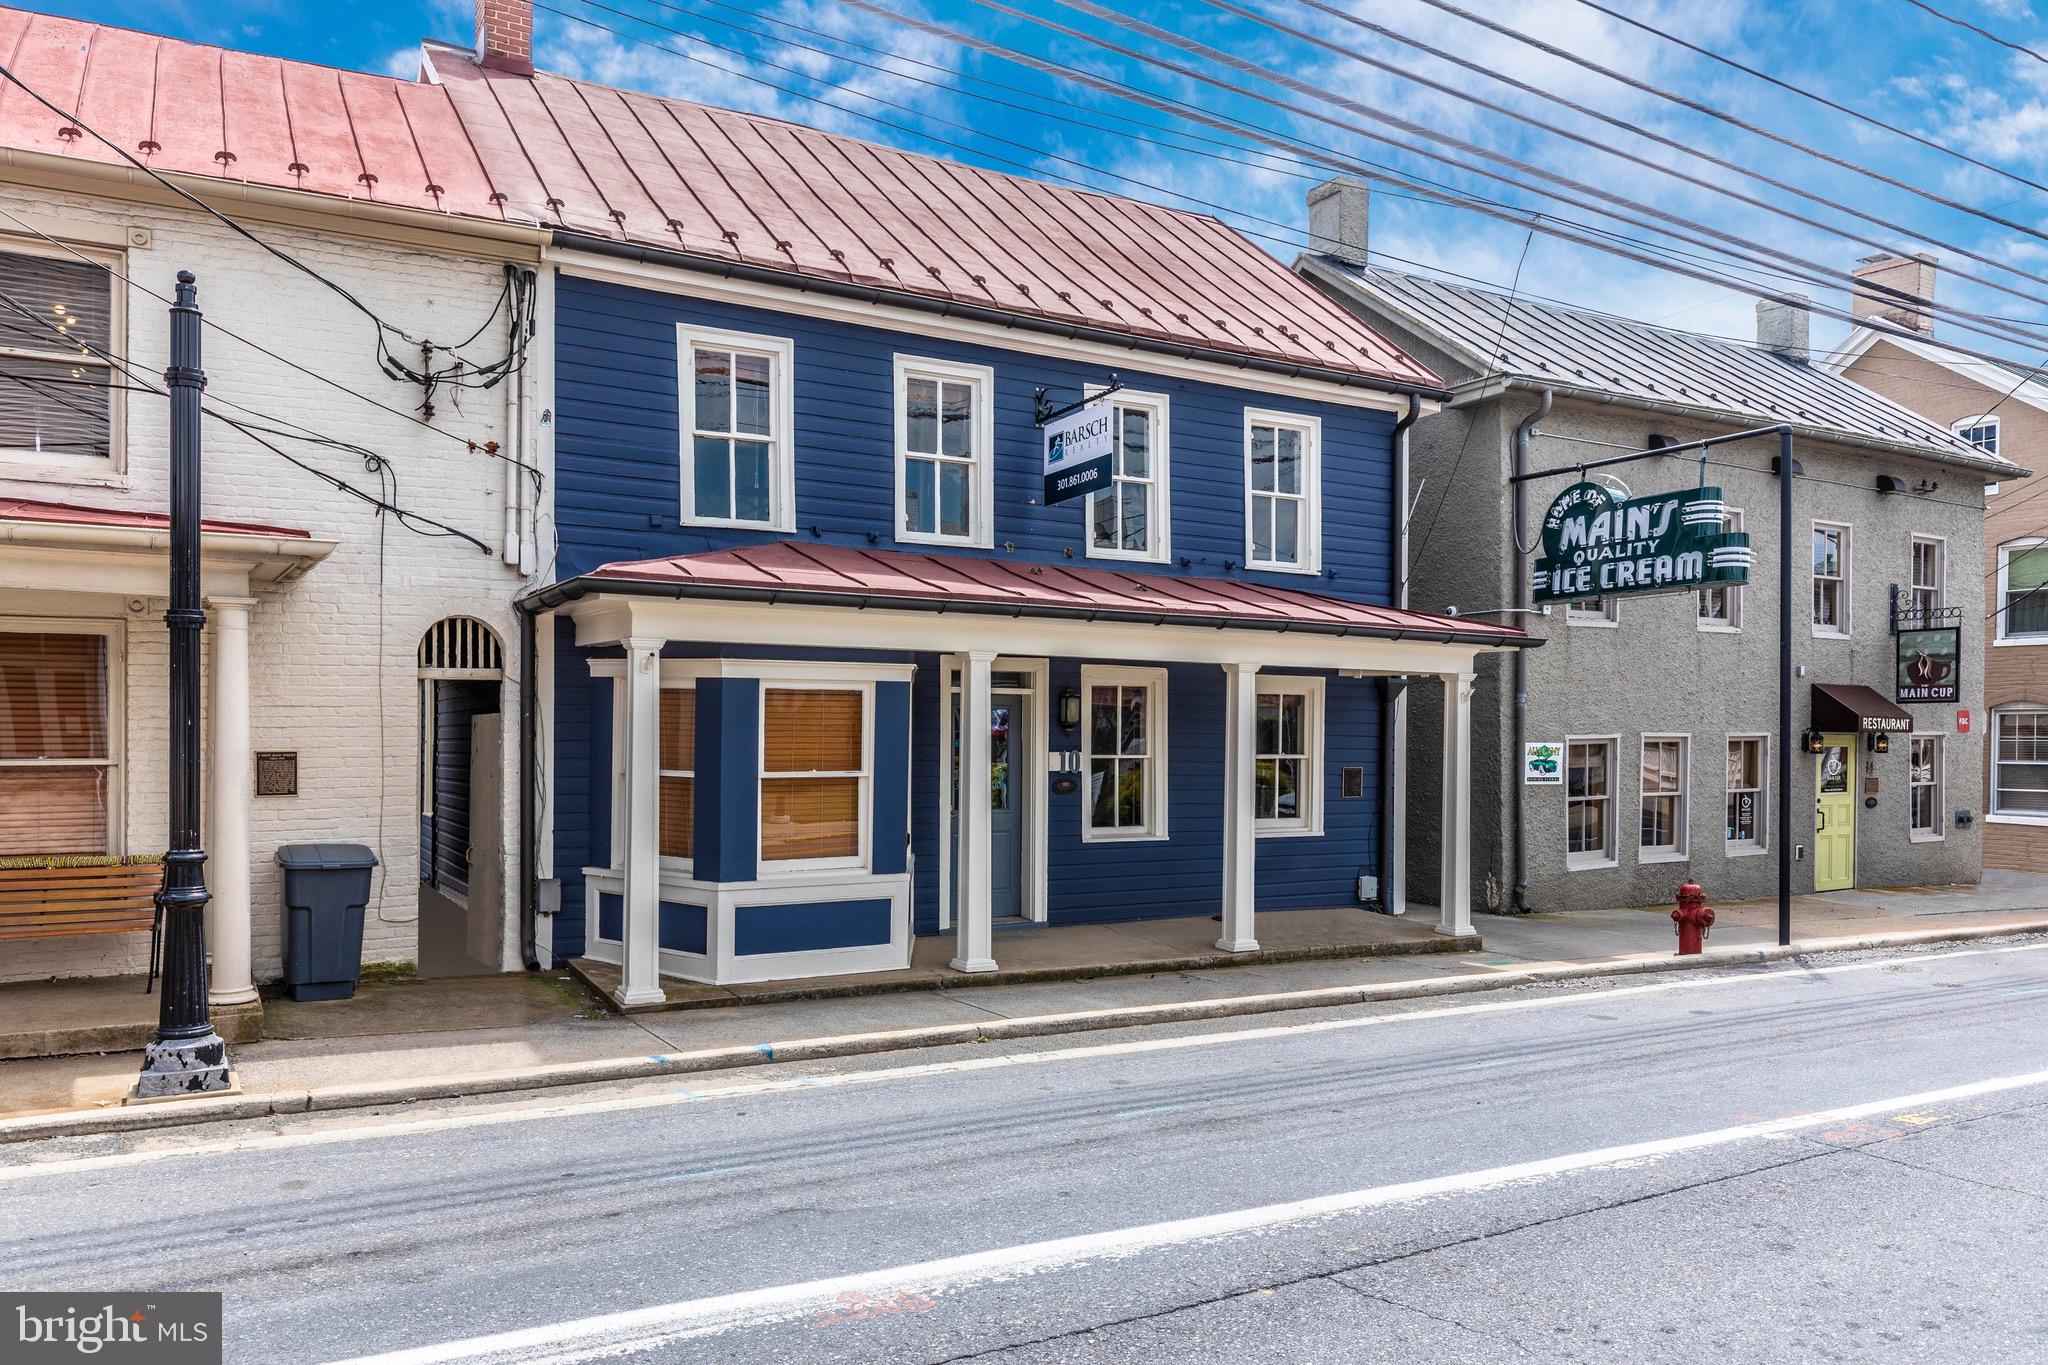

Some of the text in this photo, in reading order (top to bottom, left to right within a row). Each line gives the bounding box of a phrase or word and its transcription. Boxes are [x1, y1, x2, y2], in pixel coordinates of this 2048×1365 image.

[1065, 416, 1109, 447] BARSCH
[1065, 434, 1109, 456] REALTY
[1057, 468, 1098, 491] 301.861.0006
[1546, 488, 1606, 530] HOME OF
[1559, 499, 1679, 552] MAIN'S
[1573, 539, 1660, 565] QUALITY
[1551, 551, 1704, 595] ICE CREAM
[1900, 686, 1954, 698] MAIN CUP
[1862, 717, 1910, 730] RESTAURANT
[1059, 750, 1081, 774] 10
